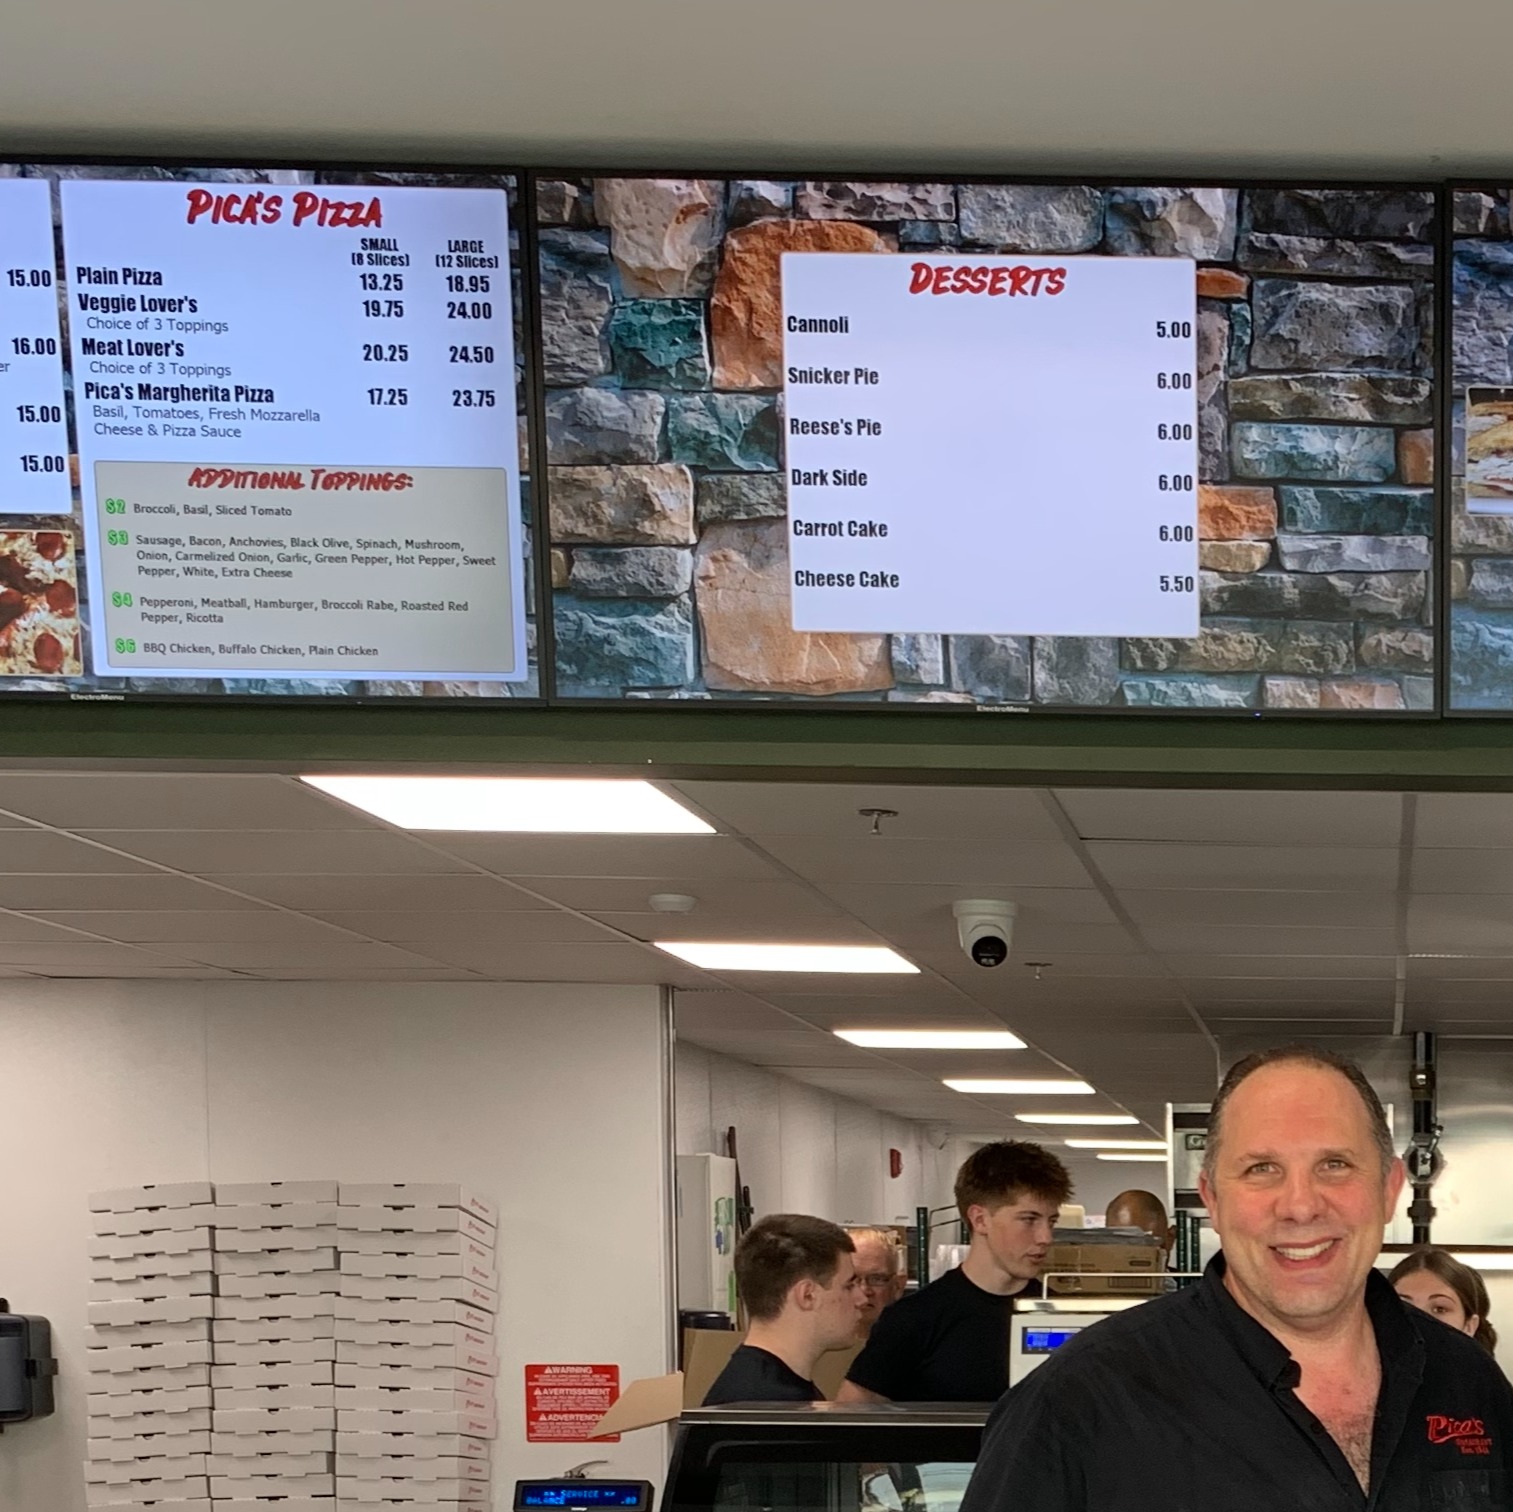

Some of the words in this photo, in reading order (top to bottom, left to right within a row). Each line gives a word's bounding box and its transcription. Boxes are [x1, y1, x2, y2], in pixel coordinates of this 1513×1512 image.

[361, 238, 399, 252] SMALL
[448, 240, 484, 254] LARGE
[7, 269, 51, 287] 15.00
[76, 267, 119, 285] Plain
[122, 268, 163, 286] Pizza
[360, 273, 403, 291] 13.25
[446, 275, 490, 293] 18.95
[78, 293, 136, 314] Veggie
[140, 295, 198, 313] Lover's
[362, 300, 404, 318] 19.75
[447, 302, 492, 319] 24.00
[87, 317, 132, 330] Choice
[136, 317, 150, 330] of
[154, 318, 163, 330] 3
[166, 318, 229, 335] Toppings
[788, 316, 849, 333] Cannoli
[1157, 321, 1191, 338] 5.00
[12, 338, 56, 355] 16.00
[82, 338, 124, 356] Meat
[127, 339, 184, 357] Lover's
[363, 344, 408, 362] 20.25
[450, 346, 494, 363] 24.50
[788, 367, 850, 385] Snicker
[854, 368, 879, 385] Pie
[1158, 372, 1192, 389] 6.00
[84, 382, 134, 400] Pica's
[138, 383, 231, 404] Margherita
[234, 385, 274, 403] Pizza
[368, 388, 408, 406] 17.25
[452, 390, 495, 407] 23.75
[16, 405, 61, 423] 15.00
[93, 405, 128, 424] Basil,
[132, 406, 204, 425] Tomatoes,
[209, 408, 246, 420] Fresh
[250, 408, 320, 422] Mozzarella
[790, 418, 853, 435] Reese's
[857, 419, 881, 436] Pie
[1158, 424, 1192, 440] 6.00
[20, 455, 64, 473] 15.00
[792, 469, 829, 486] Dark
[832, 470, 867, 486] Side
[1159, 474, 1193, 491] 6.00
[134, 504, 180, 516] Broccoli,
[184, 504, 212, 517] Basil,
[216, 505, 247, 515] Sliced
[250, 506, 292, 516] Tomato
[794, 520, 844, 537] Carrot
[848, 520, 888, 537] Cake
[1160, 525, 1193, 542] 6.00
[136, 535, 186, 548] Sausage,
[189, 536, 226, 548] Bacon,
[229, 537, 287, 549] Anchovies,
[290, 538, 319, 548] Black
[322, 538, 353, 550] Olive,
[356, 538, 402, 551] Spinach,
[405, 539, 465, 552] Mushroom,
[795, 570, 855, 587] Cheese
[860, 571, 899, 588] Cake
[1160, 576, 1194, 593] 5.50
[70, 693, 125, 701] ElectroMenu
[976, 705, 1029, 713] ElectroMenu
[552, 1366, 593, 1374] WARNING
[1426, 1415, 1484, 1443] Pica's
